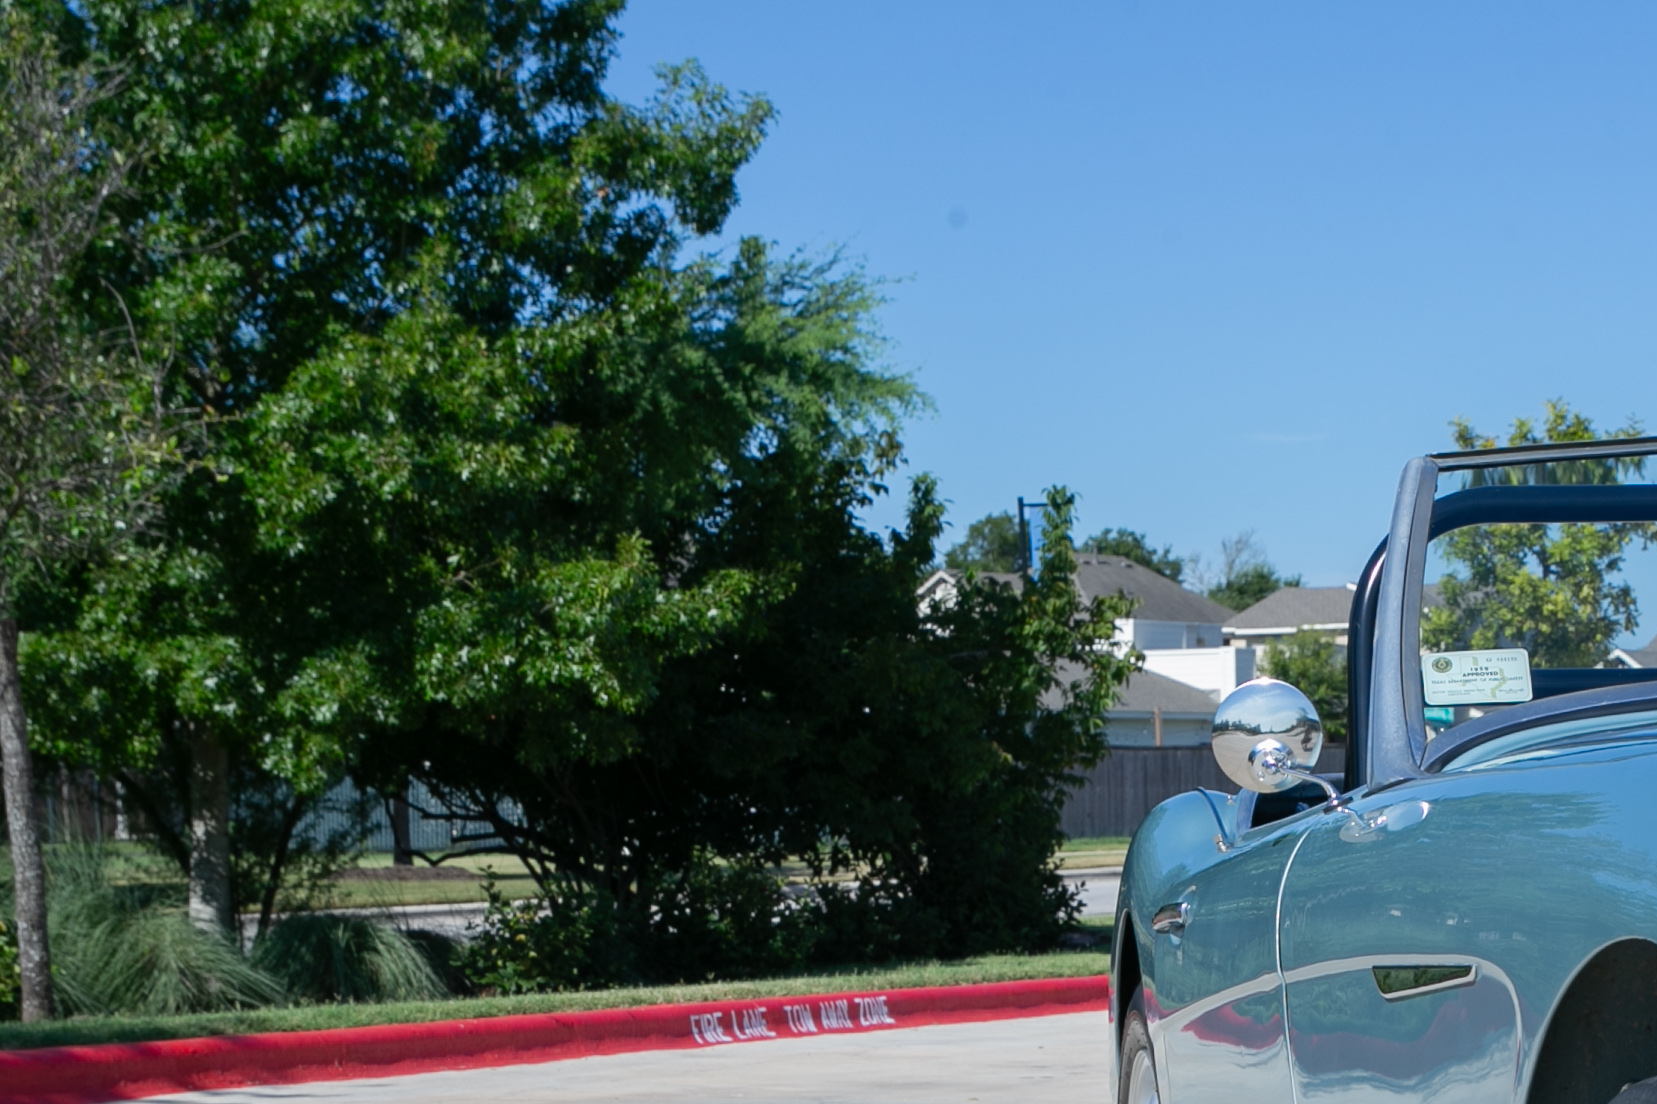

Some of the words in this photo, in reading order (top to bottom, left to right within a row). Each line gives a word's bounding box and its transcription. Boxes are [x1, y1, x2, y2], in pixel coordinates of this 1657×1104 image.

[690, 1012, 733, 1044] FIRE
[731, 1007, 776, 1040] LANE
[783, 1004, 818, 1034] TOW
[819, 999, 854, 1030] AWAY
[854, 995, 895, 1027] ZONE
